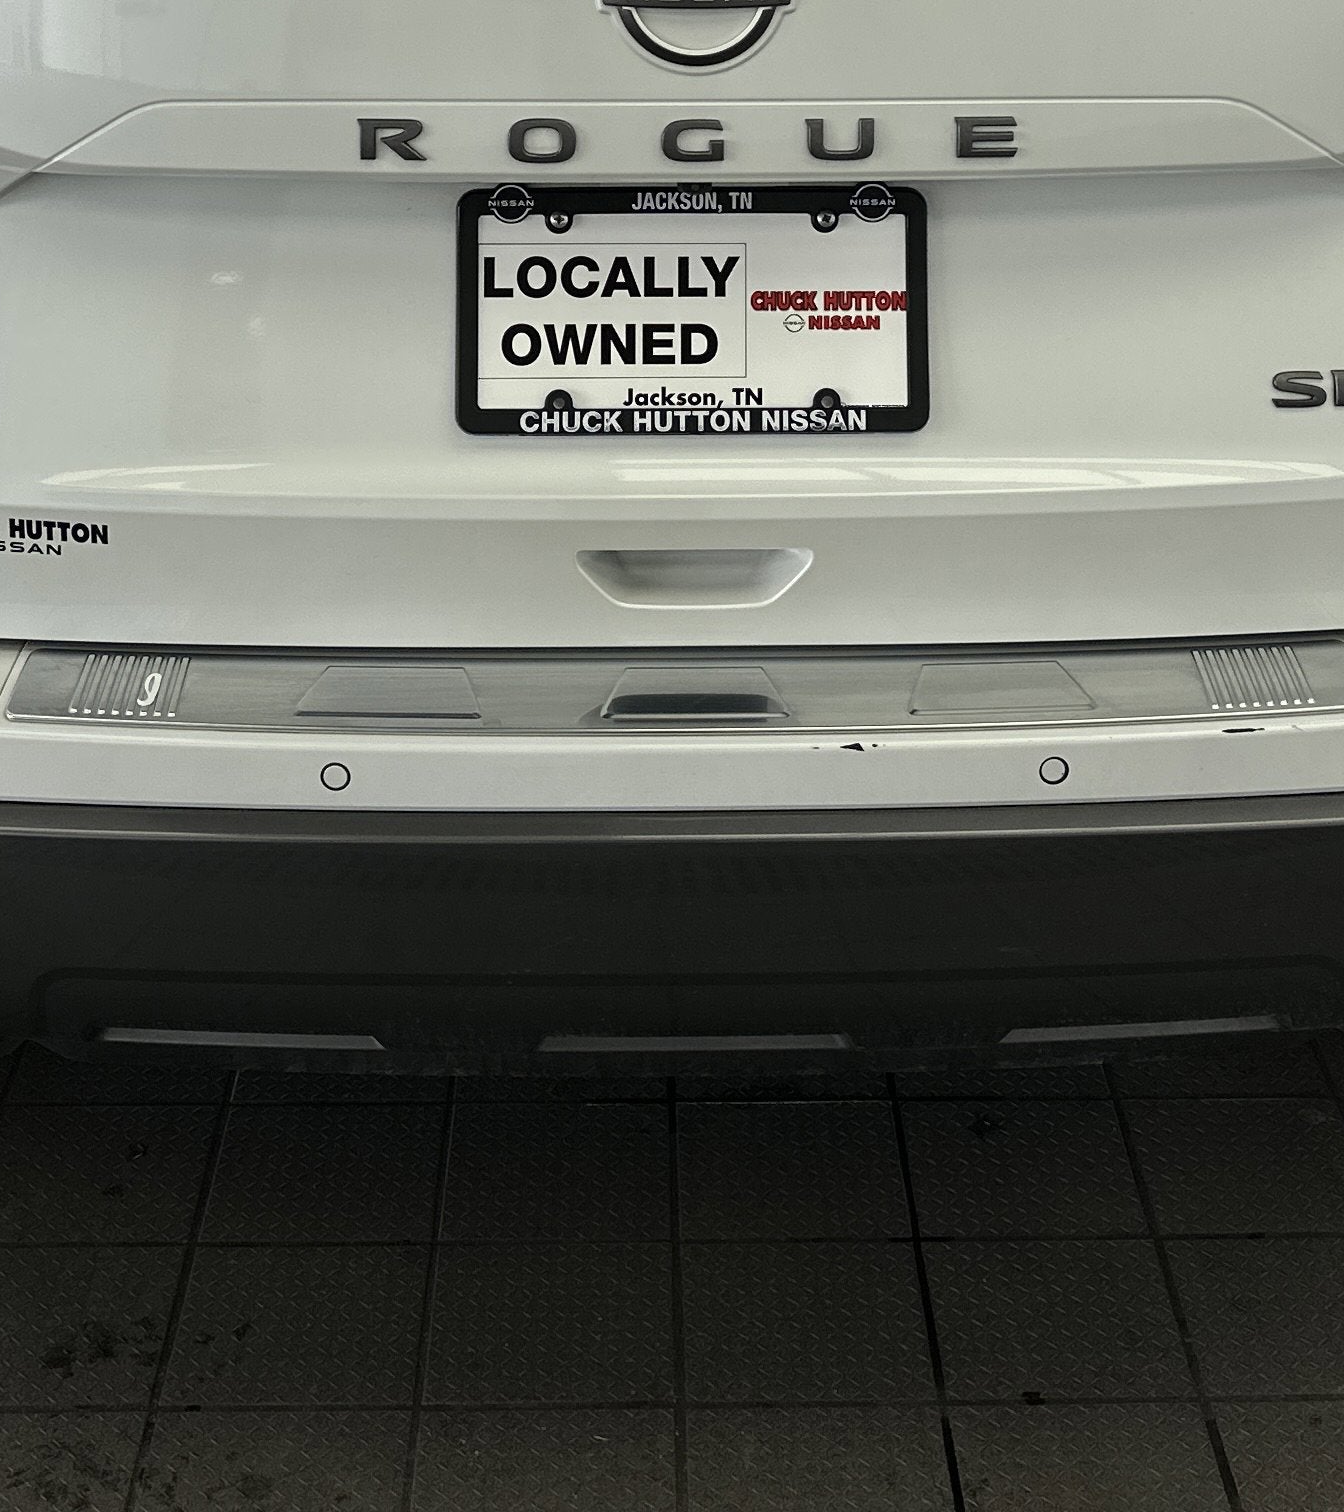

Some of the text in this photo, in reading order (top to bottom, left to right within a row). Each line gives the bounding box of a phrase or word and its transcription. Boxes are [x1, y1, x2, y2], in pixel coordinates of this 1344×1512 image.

[356, 115, 1019, 163] ROGUE
[487, 199, 535, 207] NISSAN
[631, 191, 753, 213] JACKSON, TN
[849, 198, 896, 206] NISSAN
[483, 255, 741, 299] LOCALLY
[750, 290, 907, 312] CHUCK HUTTON
[808, 315, 881, 330] NISSAN
[500, 322, 719, 367] OWNED
[622, 386, 764, 409] Jackson, TN
[518, 409, 868, 433] CHUCK HUTTON NISSAN
[8, 517, 109, 545] HUTTON
